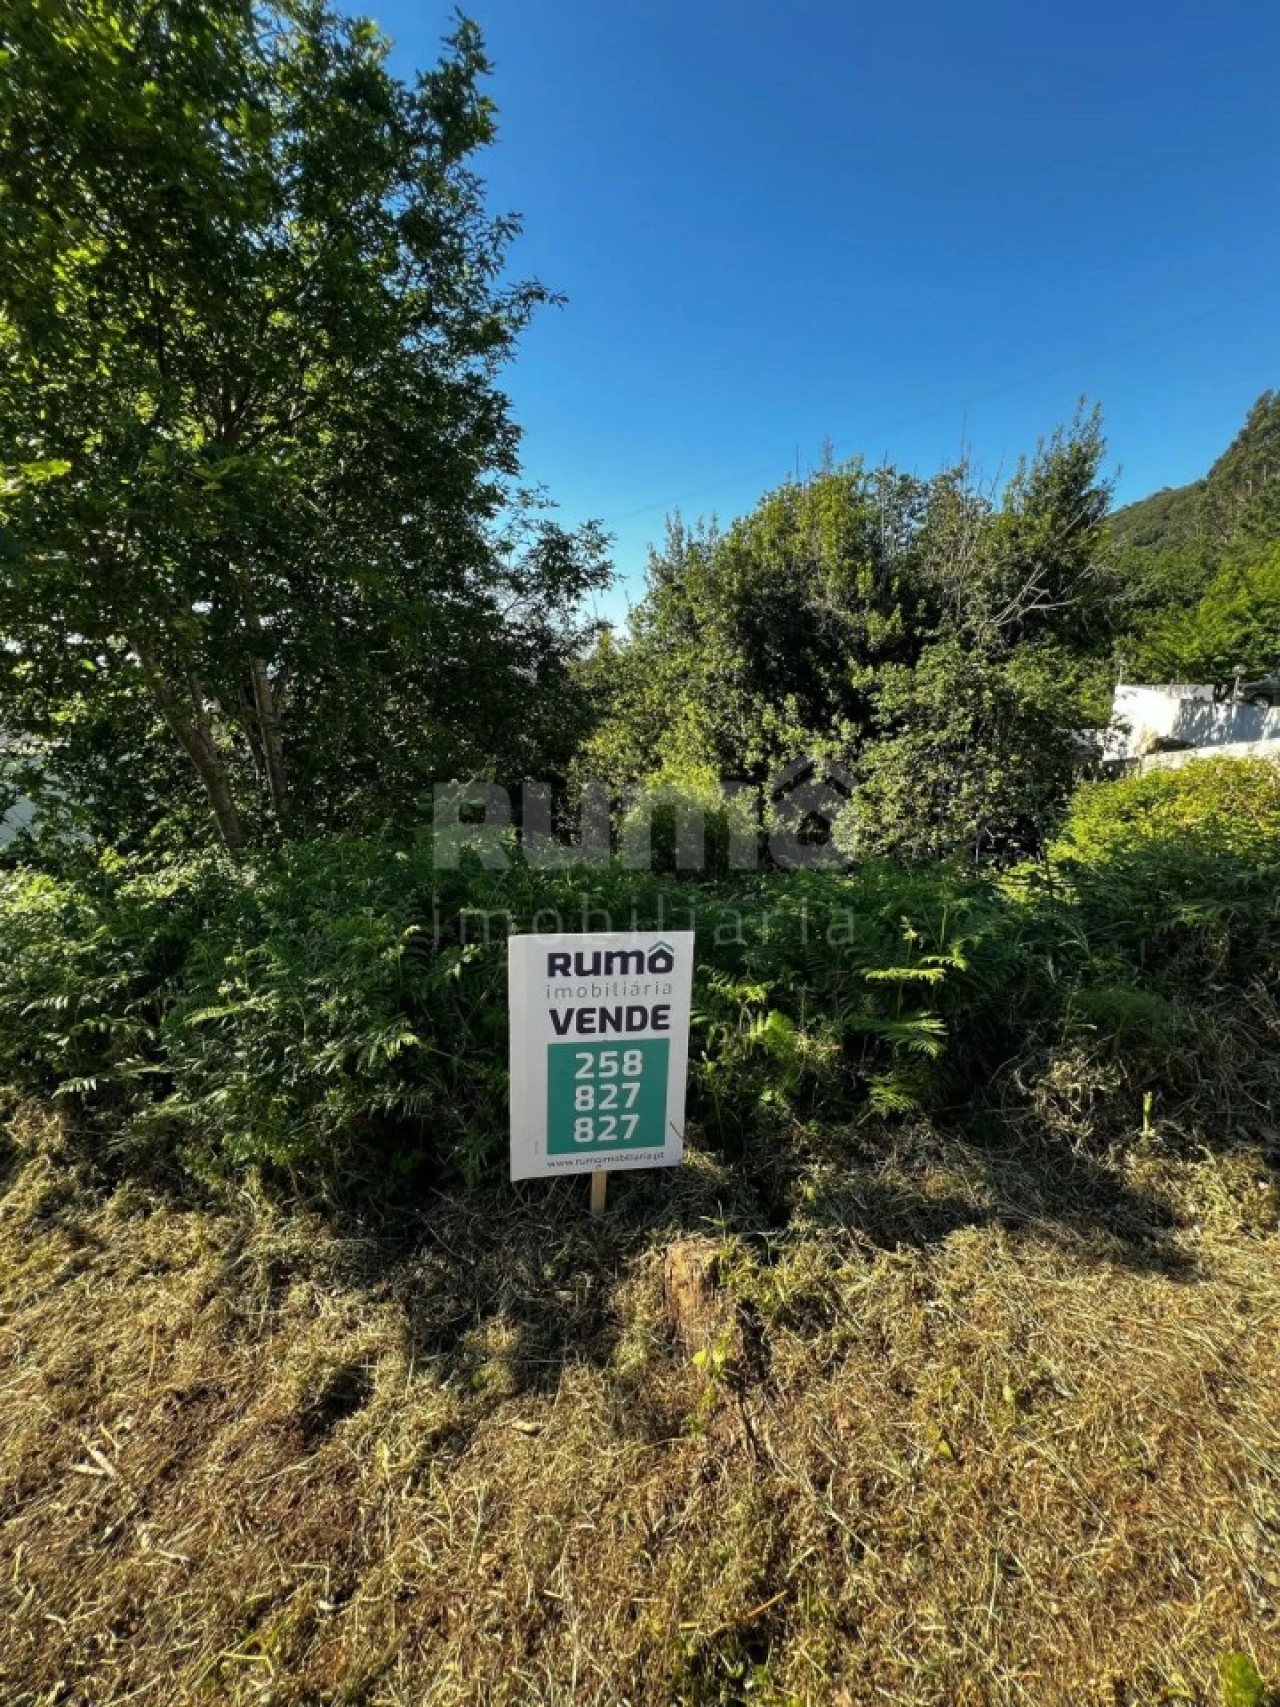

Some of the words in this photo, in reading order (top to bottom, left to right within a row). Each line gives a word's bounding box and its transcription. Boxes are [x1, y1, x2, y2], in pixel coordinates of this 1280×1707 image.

[547, 981, 673, 1000] imobiliária
[549, 1004, 671, 1035] VENDE
[574, 1049, 643, 1080] 258
[573, 1082, 641, 1112] 827
[573, 1114, 640, 1143] 827
